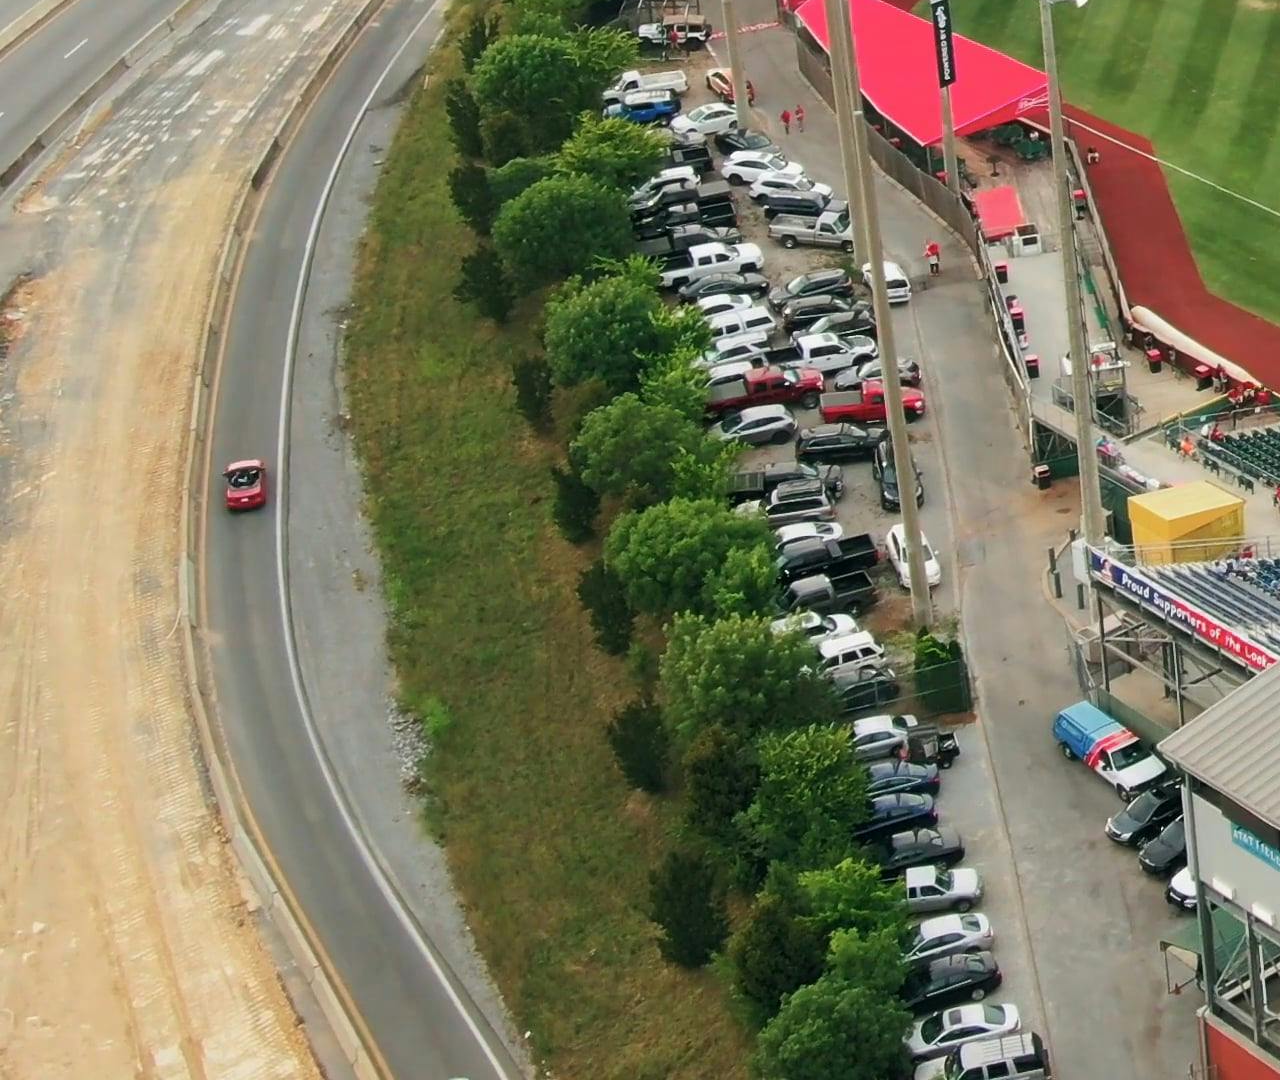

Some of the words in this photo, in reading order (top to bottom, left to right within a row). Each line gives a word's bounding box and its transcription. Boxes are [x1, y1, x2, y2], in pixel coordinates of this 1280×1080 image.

[939, 29, 947, 40] BY
[940, 40, 951, 80] POWERED
[1121, 572, 1149, 599] Proud
[1153, 592, 1207, 633] Supporters
[1210, 627, 1222, 643] of
[1225, 636, 1241, 653] the
[1233, 828, 1254, 846] AT&T
